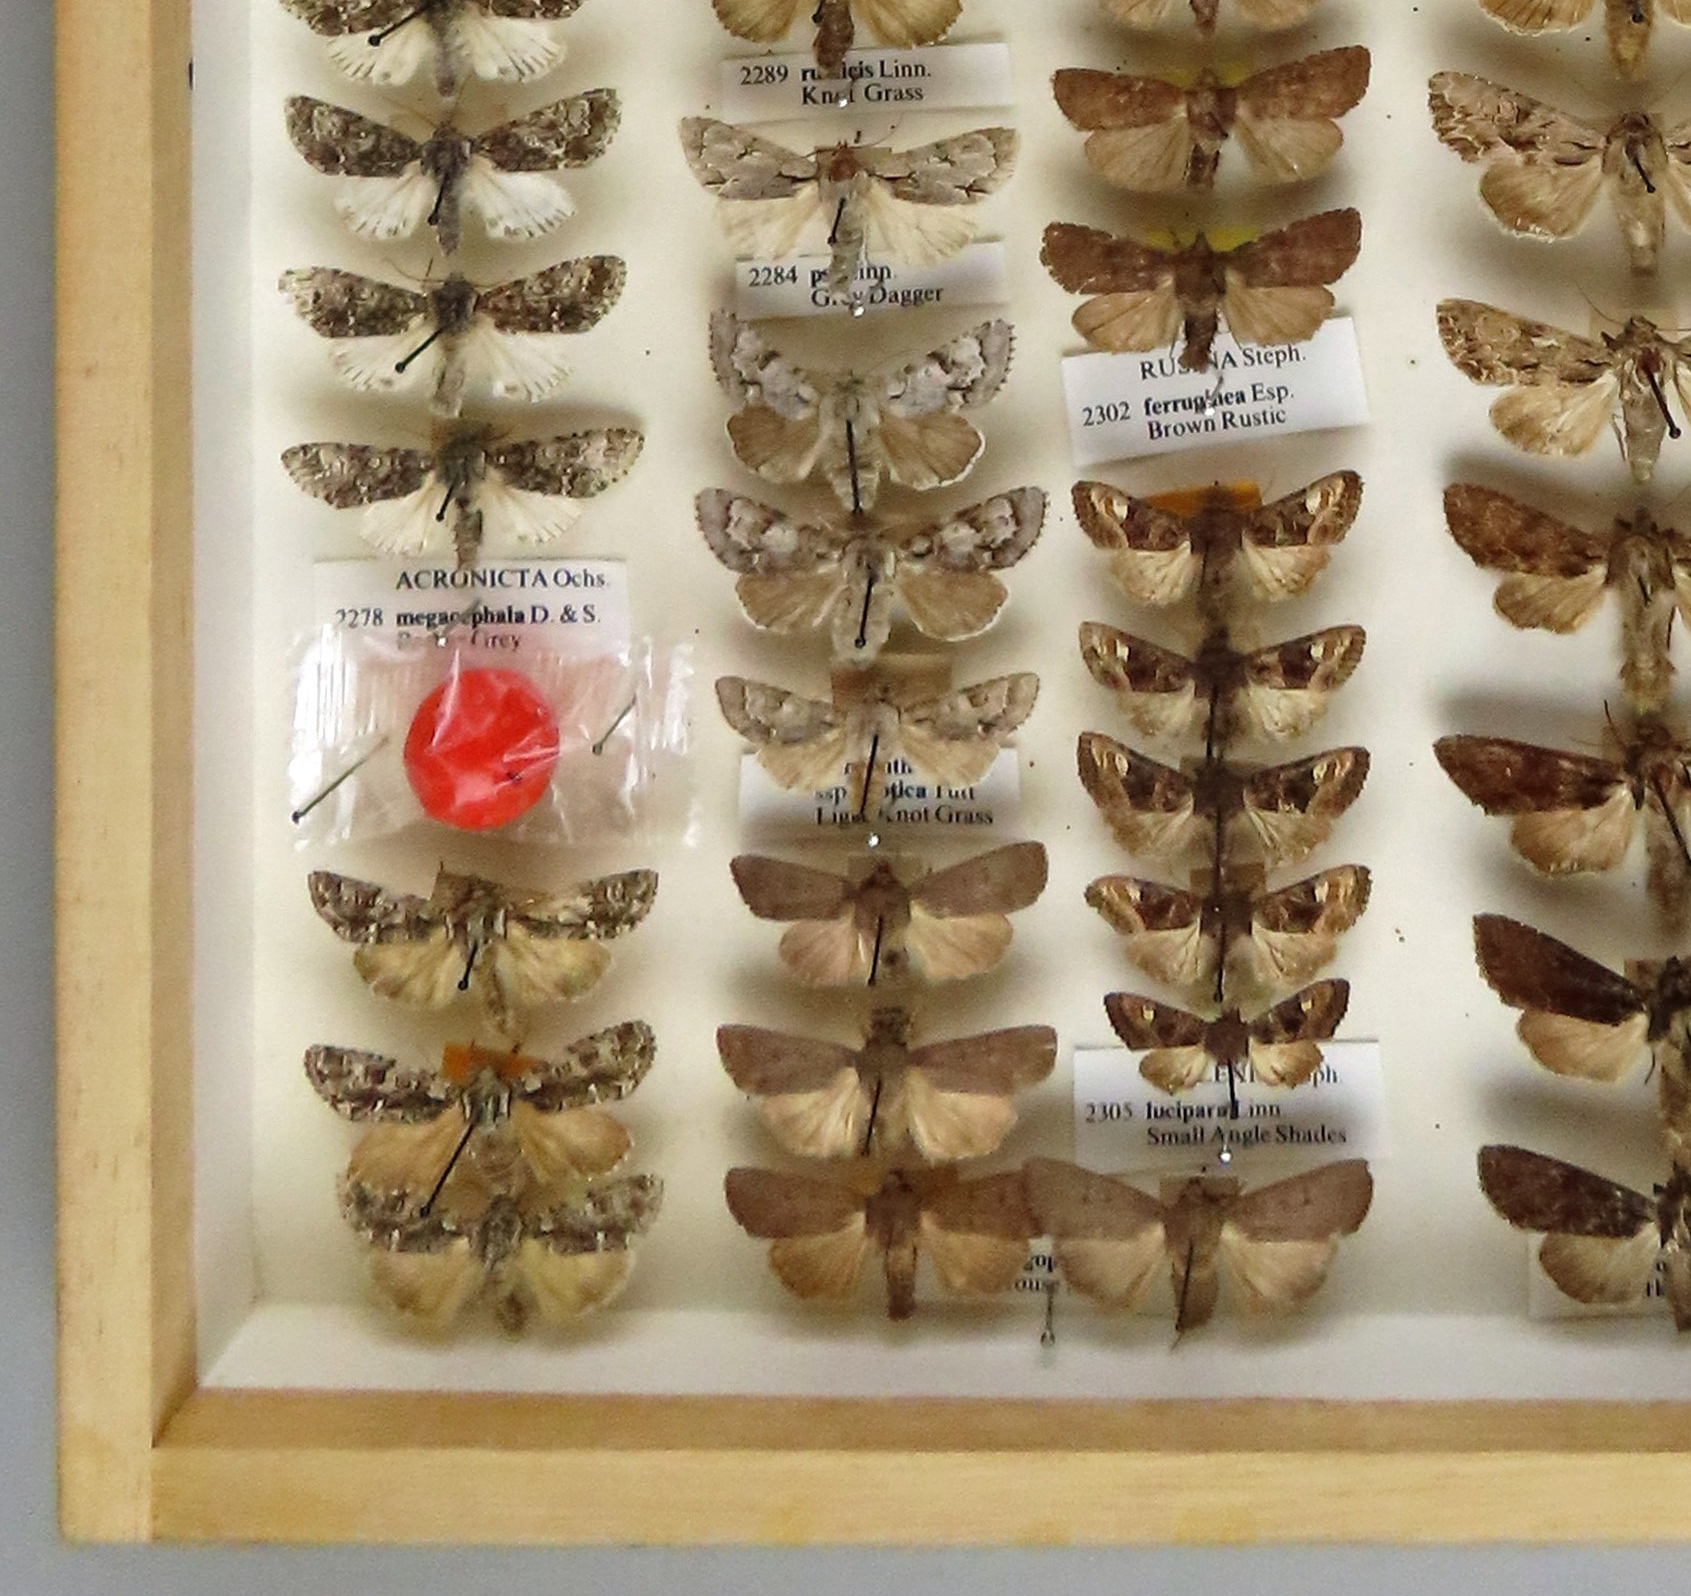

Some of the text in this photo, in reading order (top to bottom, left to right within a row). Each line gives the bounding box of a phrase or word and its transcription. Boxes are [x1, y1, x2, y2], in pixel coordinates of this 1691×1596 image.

[740, 66, 789, 85] 2289
[879, 61, 931, 79] Linn.
[865, 84, 923, 102] Grass
[749, 266, 798, 287] 2284
[870, 287, 944, 306] Dagger
[1242, 344, 1305, 367] Steph.
[1083, 402, 1131, 427] 2302
[1252, 383, 1294, 405] Esp.
[1147, 407, 1287, 441] Brown Rustic
[396, 569, 549, 590] ACRONICTA
[530, 606, 554, 624] D.
[561, 606, 577, 623] &
[583, 605, 600, 623] S.
[935, 808, 994, 825] Grass
[1086, 1104, 1133, 1122] 2305
[1147, 1126, 1347, 1150] Small Angle Shades
